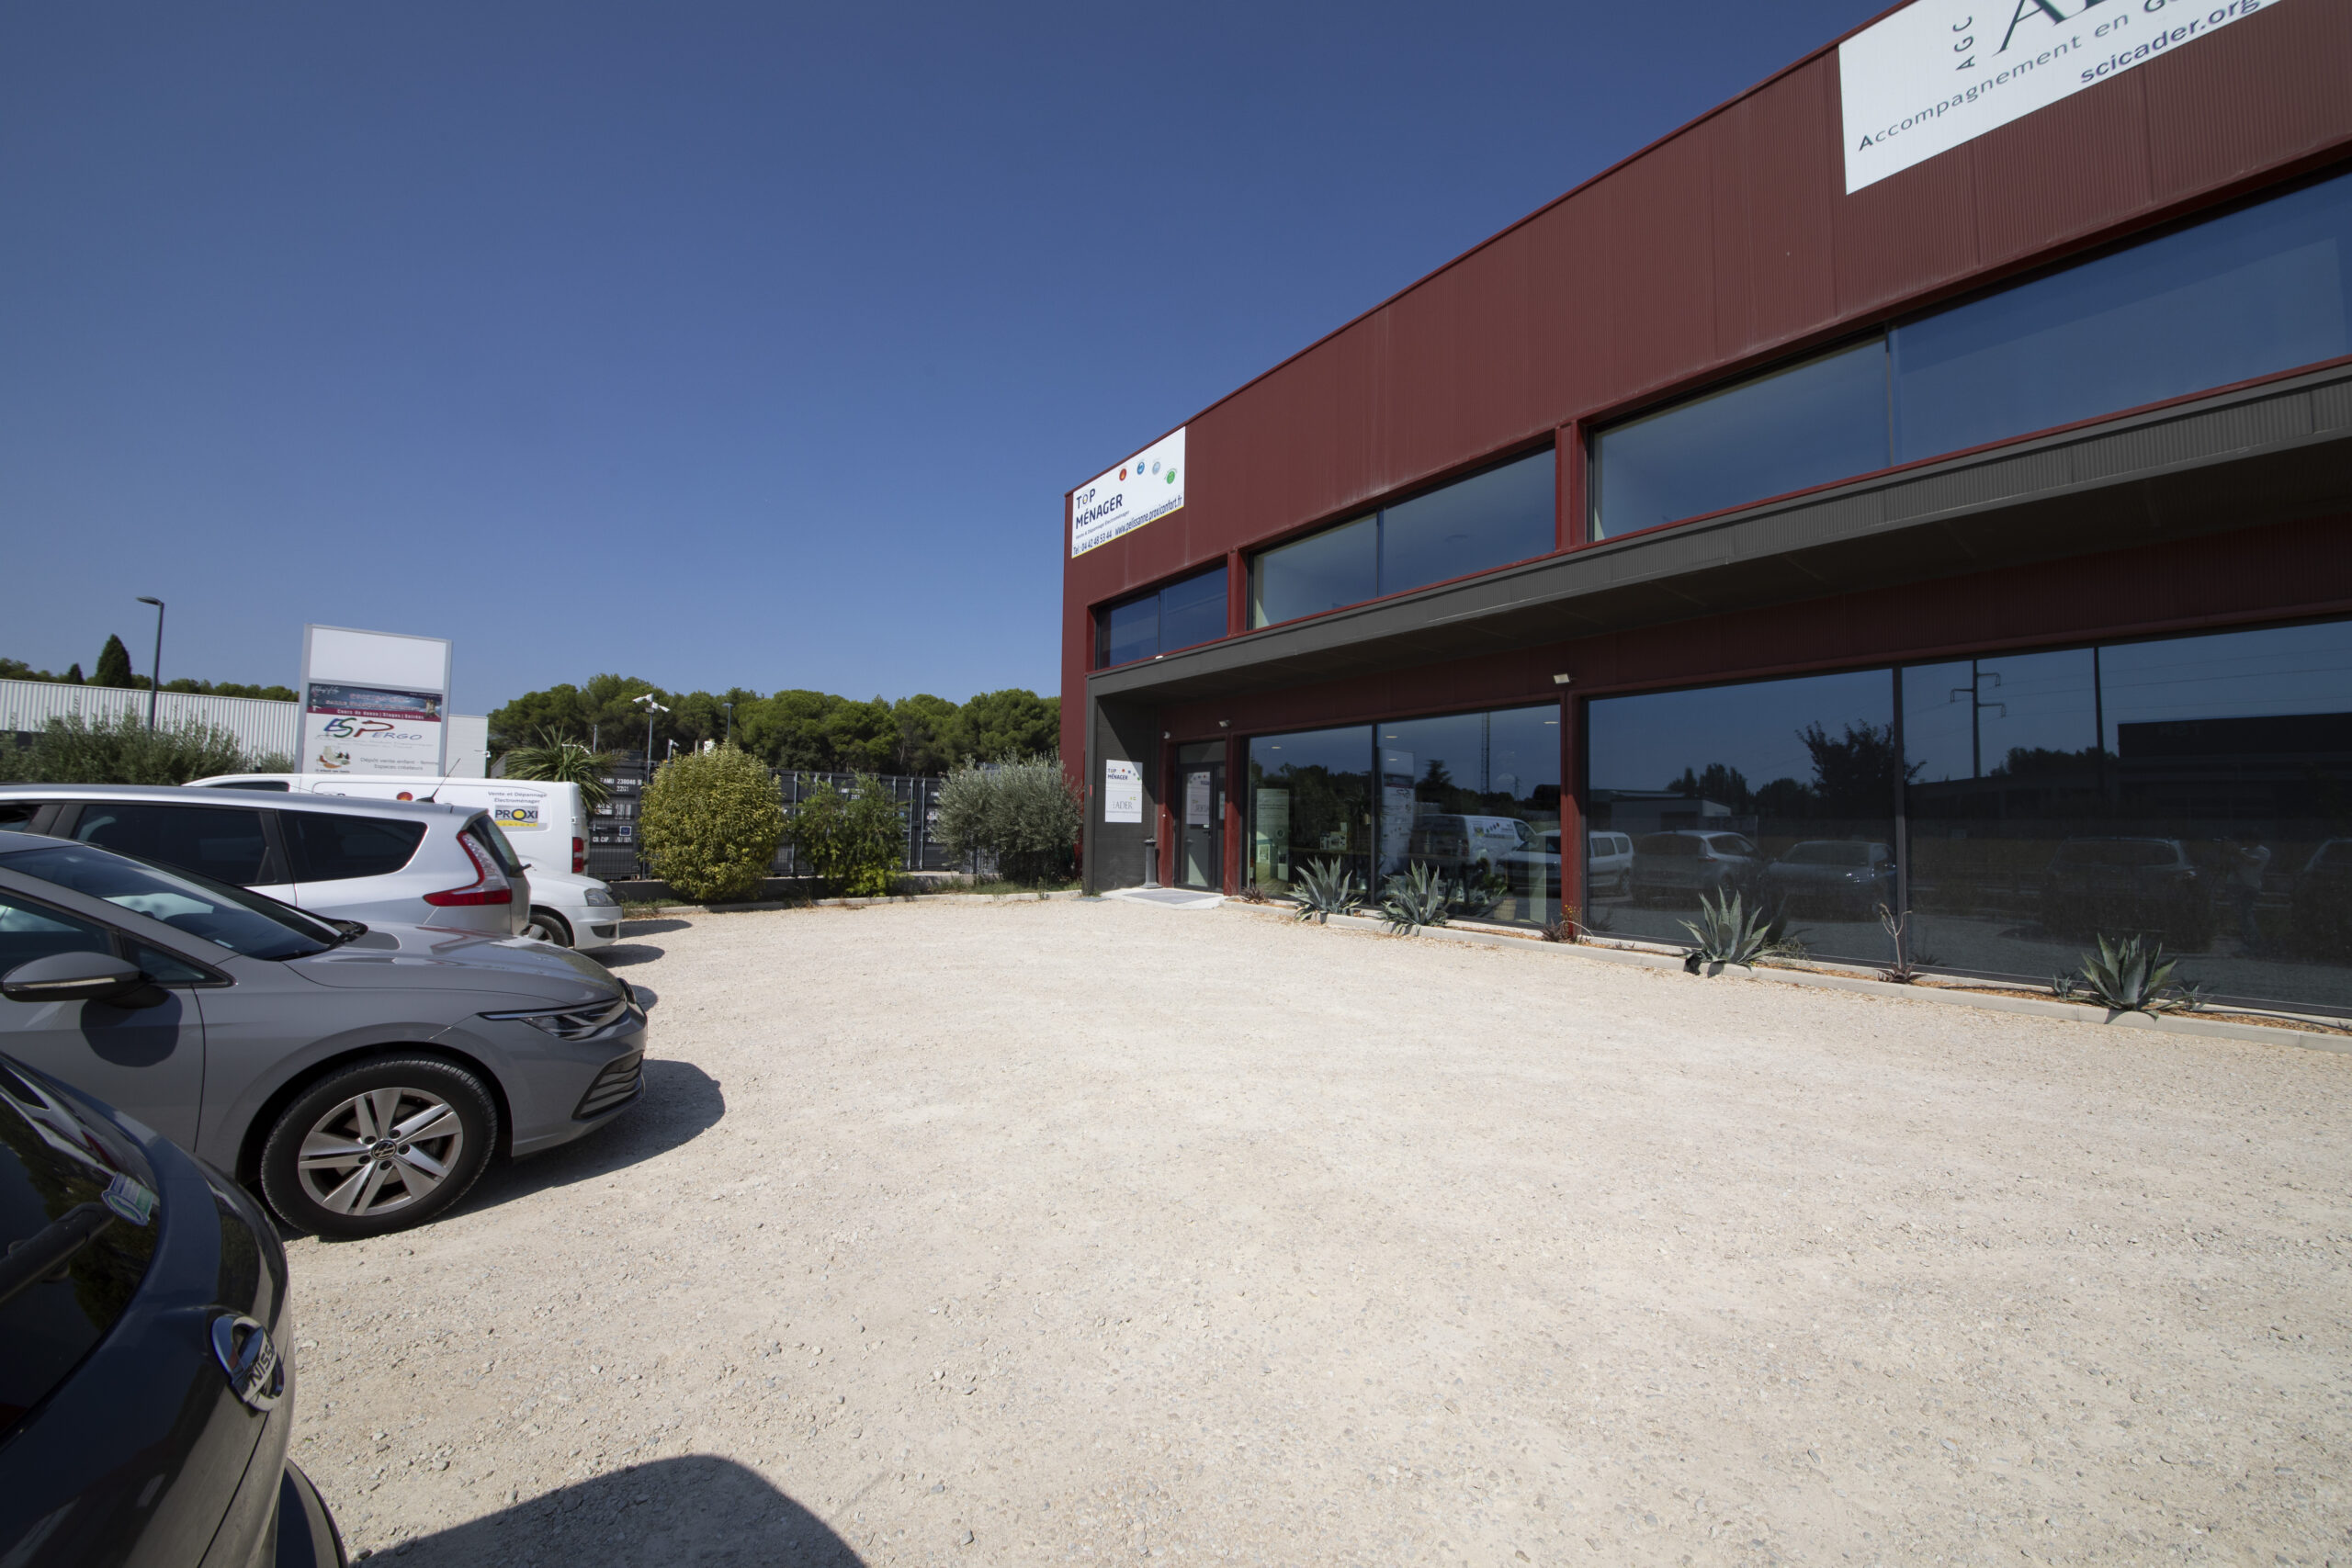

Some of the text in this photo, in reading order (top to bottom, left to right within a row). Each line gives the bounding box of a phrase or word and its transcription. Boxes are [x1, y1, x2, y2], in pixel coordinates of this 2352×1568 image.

[2081, 0, 2260, 84] scicader.org
[1858, 35, 2082, 152] Accompagnement
[2095, 14, 2129, 38] en
[1076, 488, 1096, 509] TOP
[1076, 493, 1123, 530] MÉNAGER
[1106, 530, 1112, 539] 44
[494, 808, 538, 820] PROXI
